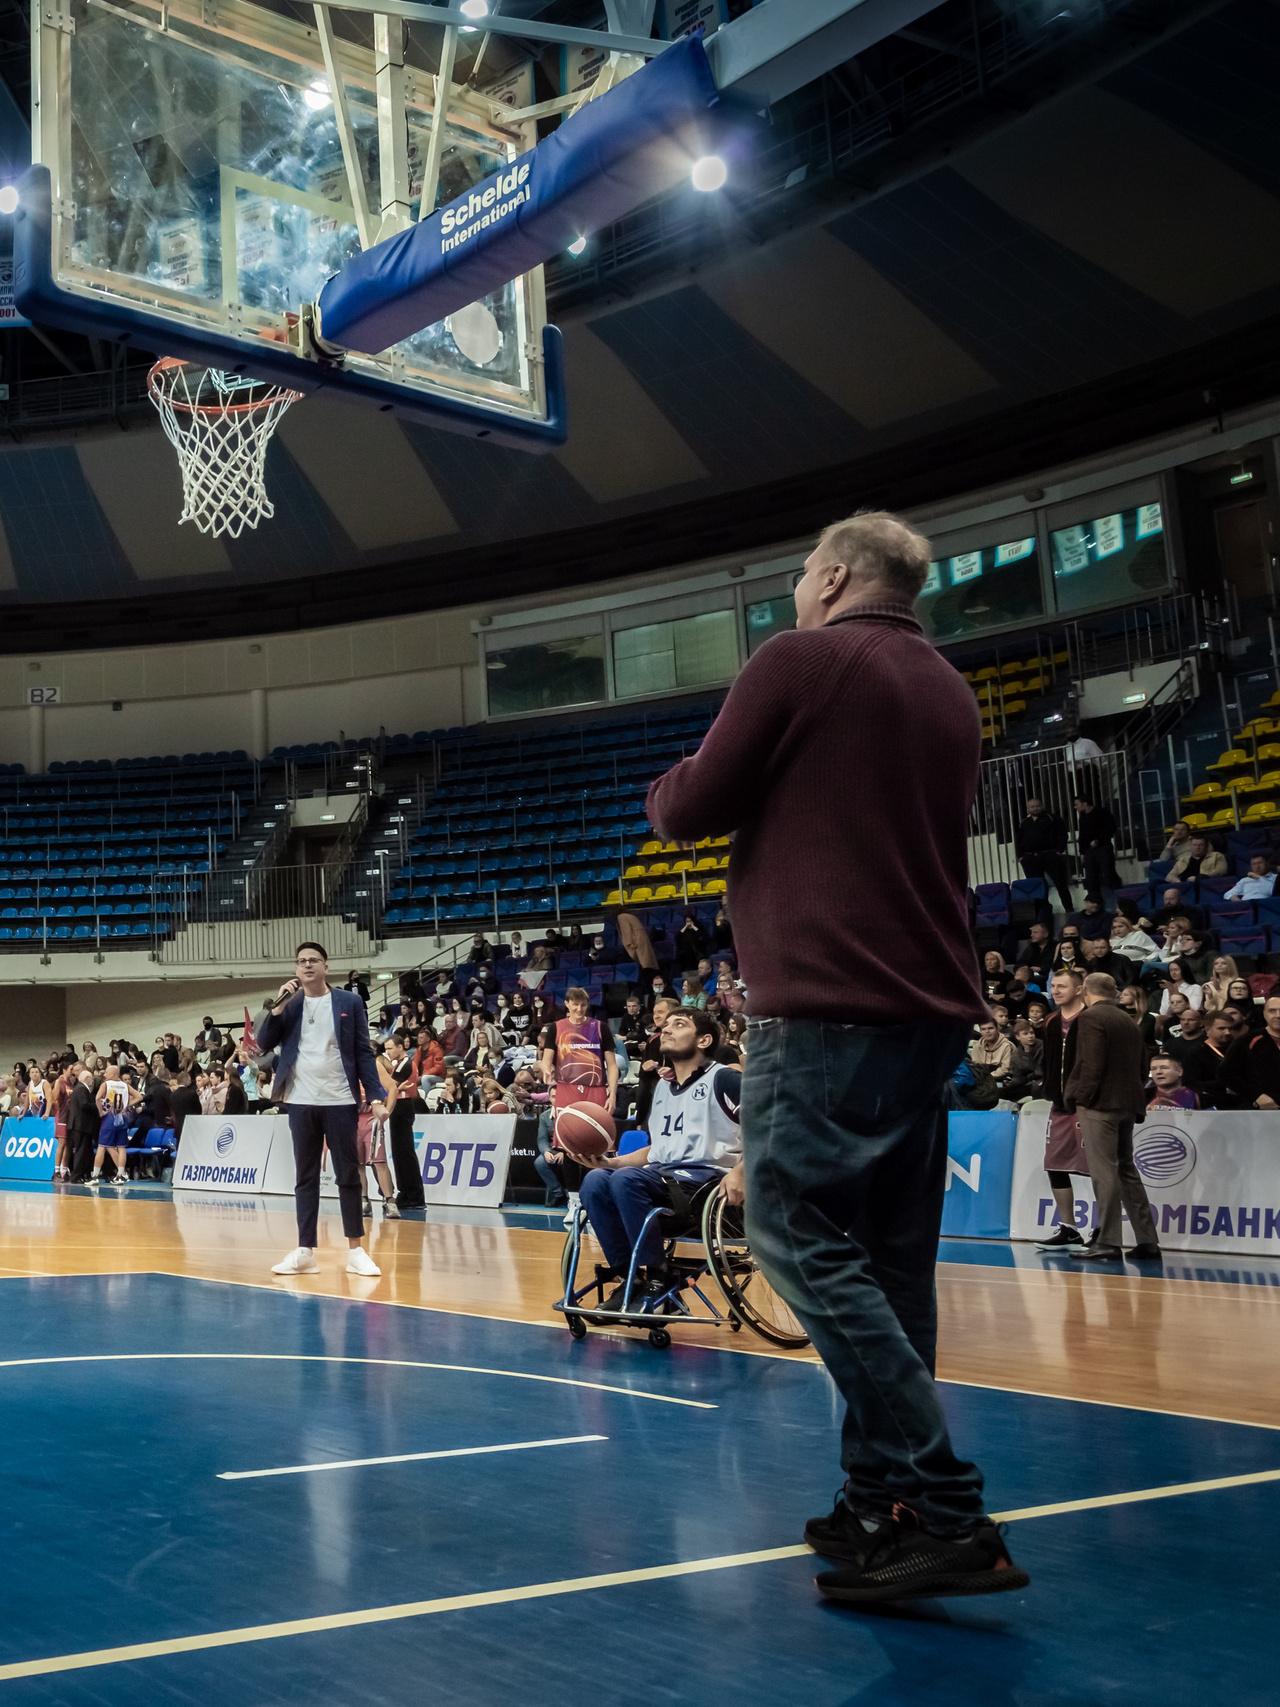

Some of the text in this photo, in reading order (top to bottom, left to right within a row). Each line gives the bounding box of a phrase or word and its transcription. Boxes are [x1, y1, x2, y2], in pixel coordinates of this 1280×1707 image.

[440, 164, 530, 234] Schelde
[442, 184, 530, 254] International
[661, 1111, 684, 1136] 14
[5, 1137, 54, 1158] OZON
[510, 1148, 535, 1156] sket.ru
[181, 1165, 258, 1184] ГАЗПРОМБАНК
[422, 1142, 498, 1187] ВТБ
[1038, 1198, 1280, 1239] ГЗМБАНК
